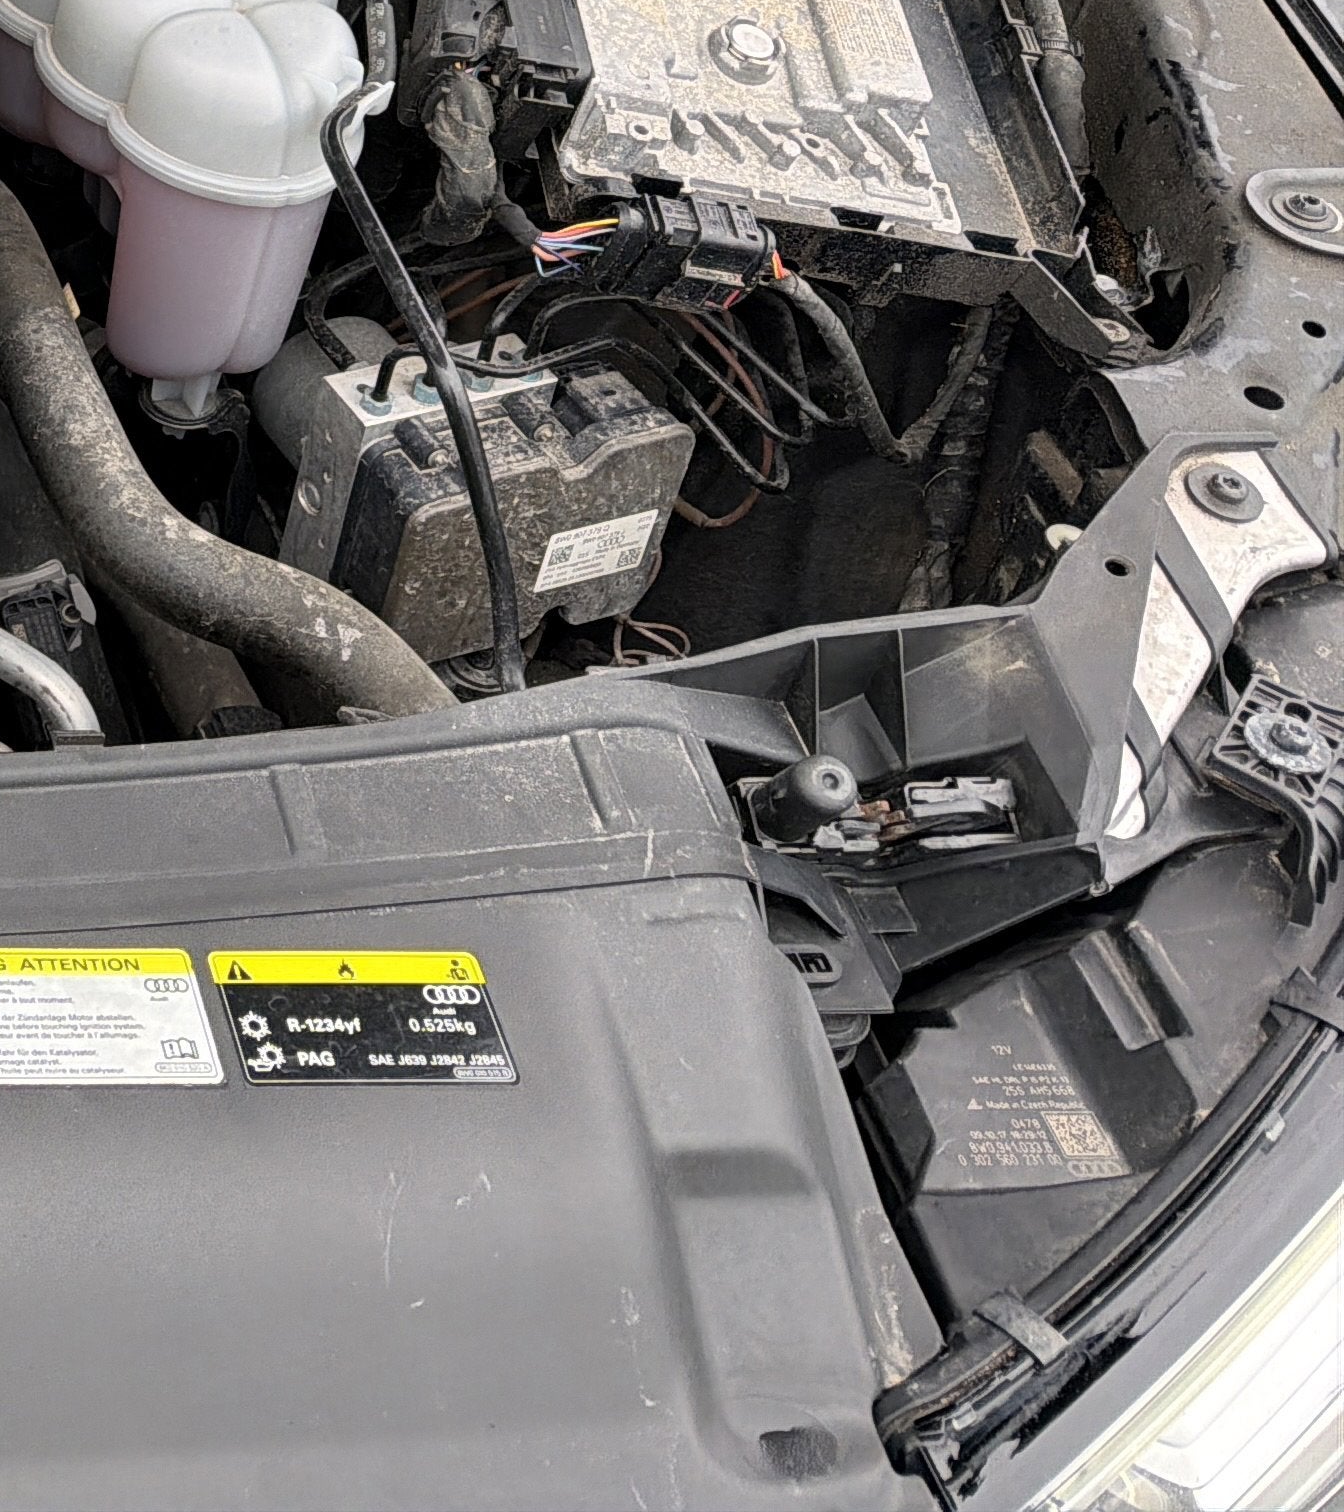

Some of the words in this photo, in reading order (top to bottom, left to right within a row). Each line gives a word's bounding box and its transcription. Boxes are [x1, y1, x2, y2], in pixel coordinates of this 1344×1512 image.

[19, 957, 140, 972] ATTENTION
[19, 996, 36, 1004] tout
[432, 1006, 457, 1016] Audi
[1, 1014, 16, 1022] der
[17, 1014, 67, 1023] Zündanlage
[41, 1023, 79, 1031] touching
[79, 1023, 112, 1031] ignition
[286, 1017, 362, 1035] R-1234yf
[408, 1018, 477, 1036] 0.525kg
[53, 1031, 85, 1039] toucher
[991, 1045, 1012, 1056] 12V
[297, 1051, 335, 1067] PAG
[368, 1054, 395, 1066] SAE
[398, 1054, 428, 1066] J639
[429, 1054, 467, 1066] J2842
[469, 1054, 506, 1066] J2845
[24, 1067, 44, 1076] peut
[985, 1100, 1012, 1109] Made
[1020, 1099, 1048, 1109] Czech
[1048, 1100, 1087, 1110] Republic
[970, 1153, 993, 1167] 302
[995, 1153, 1020, 1167] 560
[1021, 1153, 1045, 1166] 231
[1047, 1153, 1064, 1166] 00
